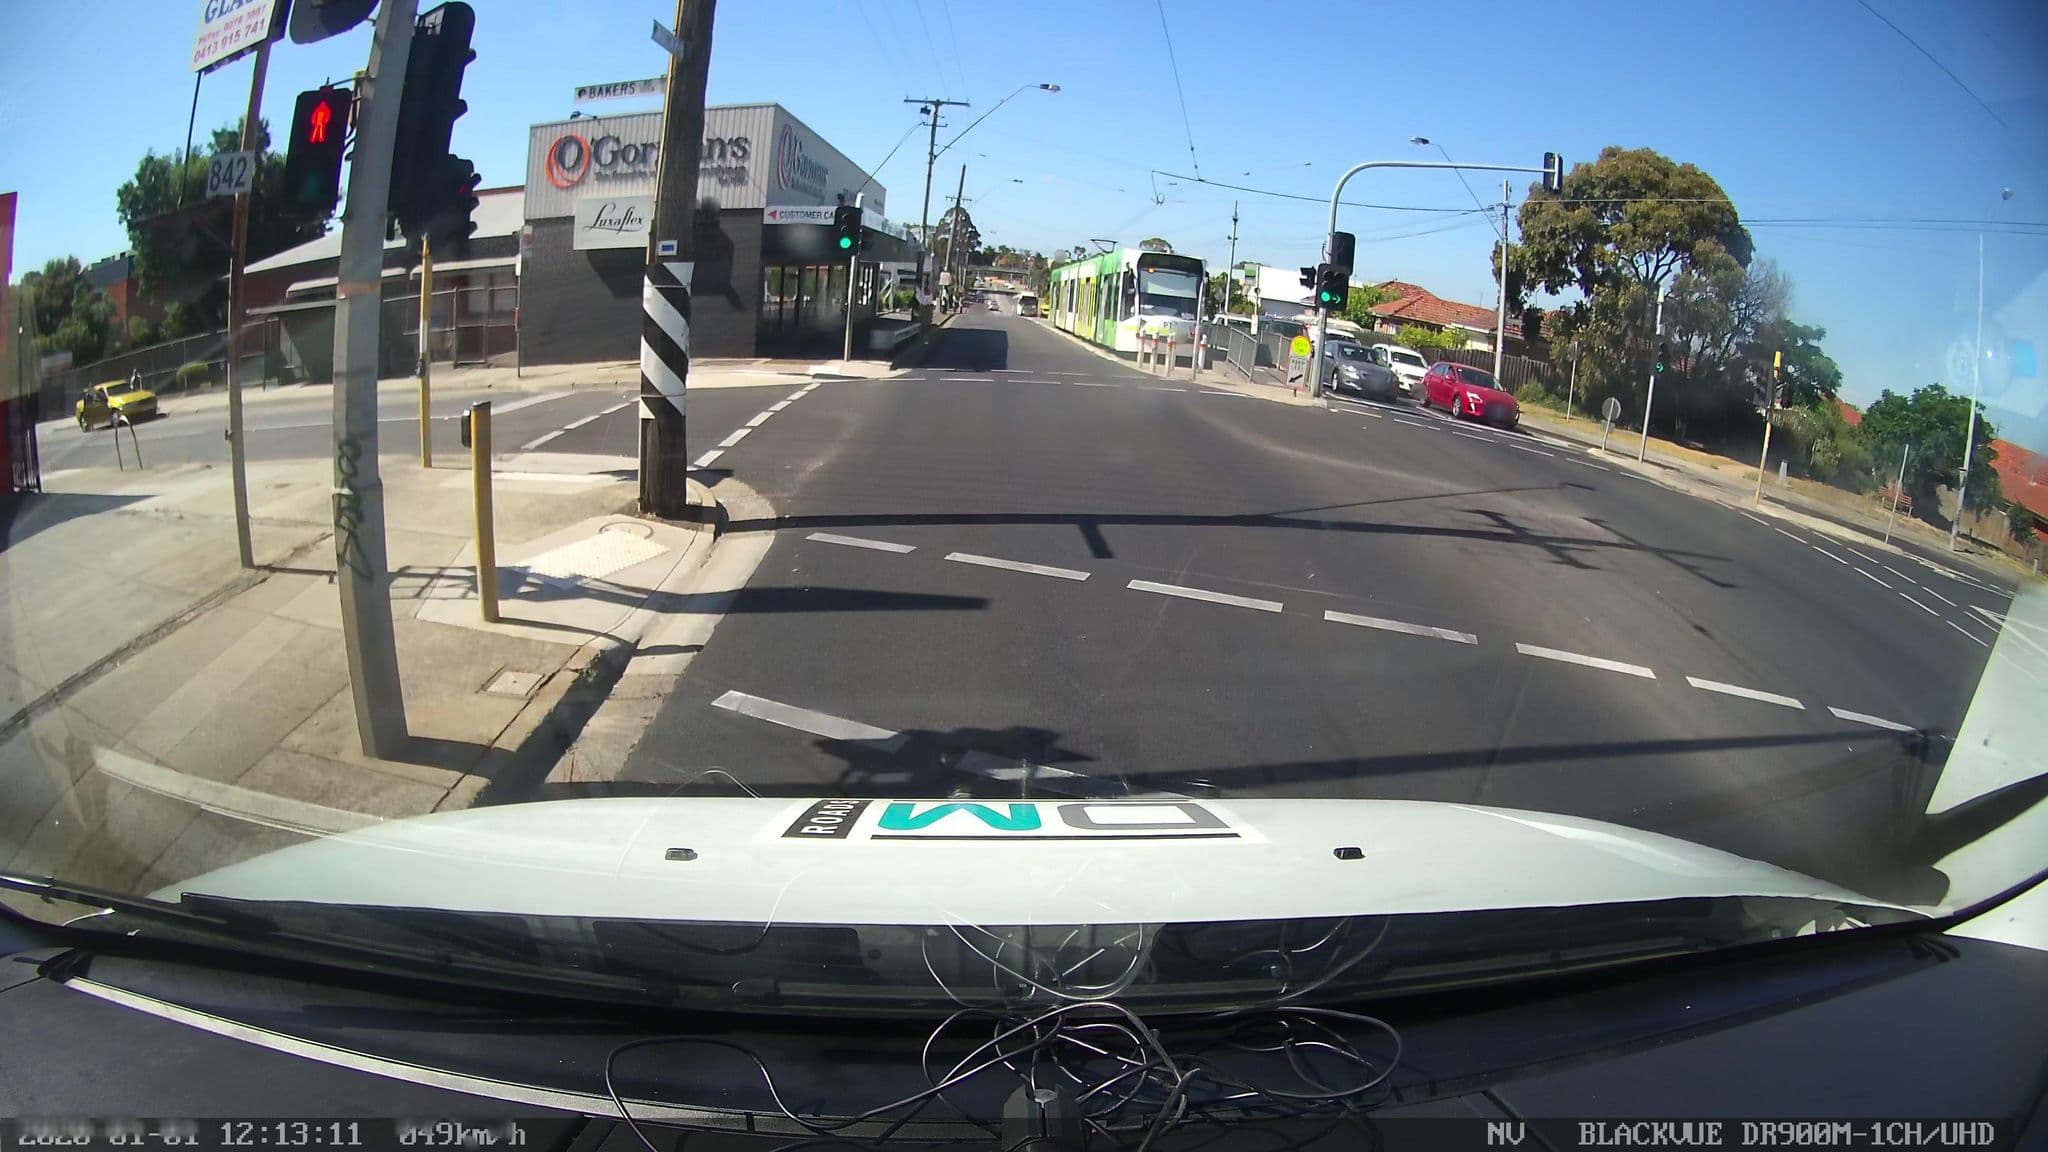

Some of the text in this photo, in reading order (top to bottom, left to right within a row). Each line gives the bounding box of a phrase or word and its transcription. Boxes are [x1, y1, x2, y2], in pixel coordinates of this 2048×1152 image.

[589, 83, 635, 98] BAKERS
[210, 157, 247, 191] 842
[584, 203, 643, 234] Luxaflex
[780, 210, 821, 220] CUSTOMER
